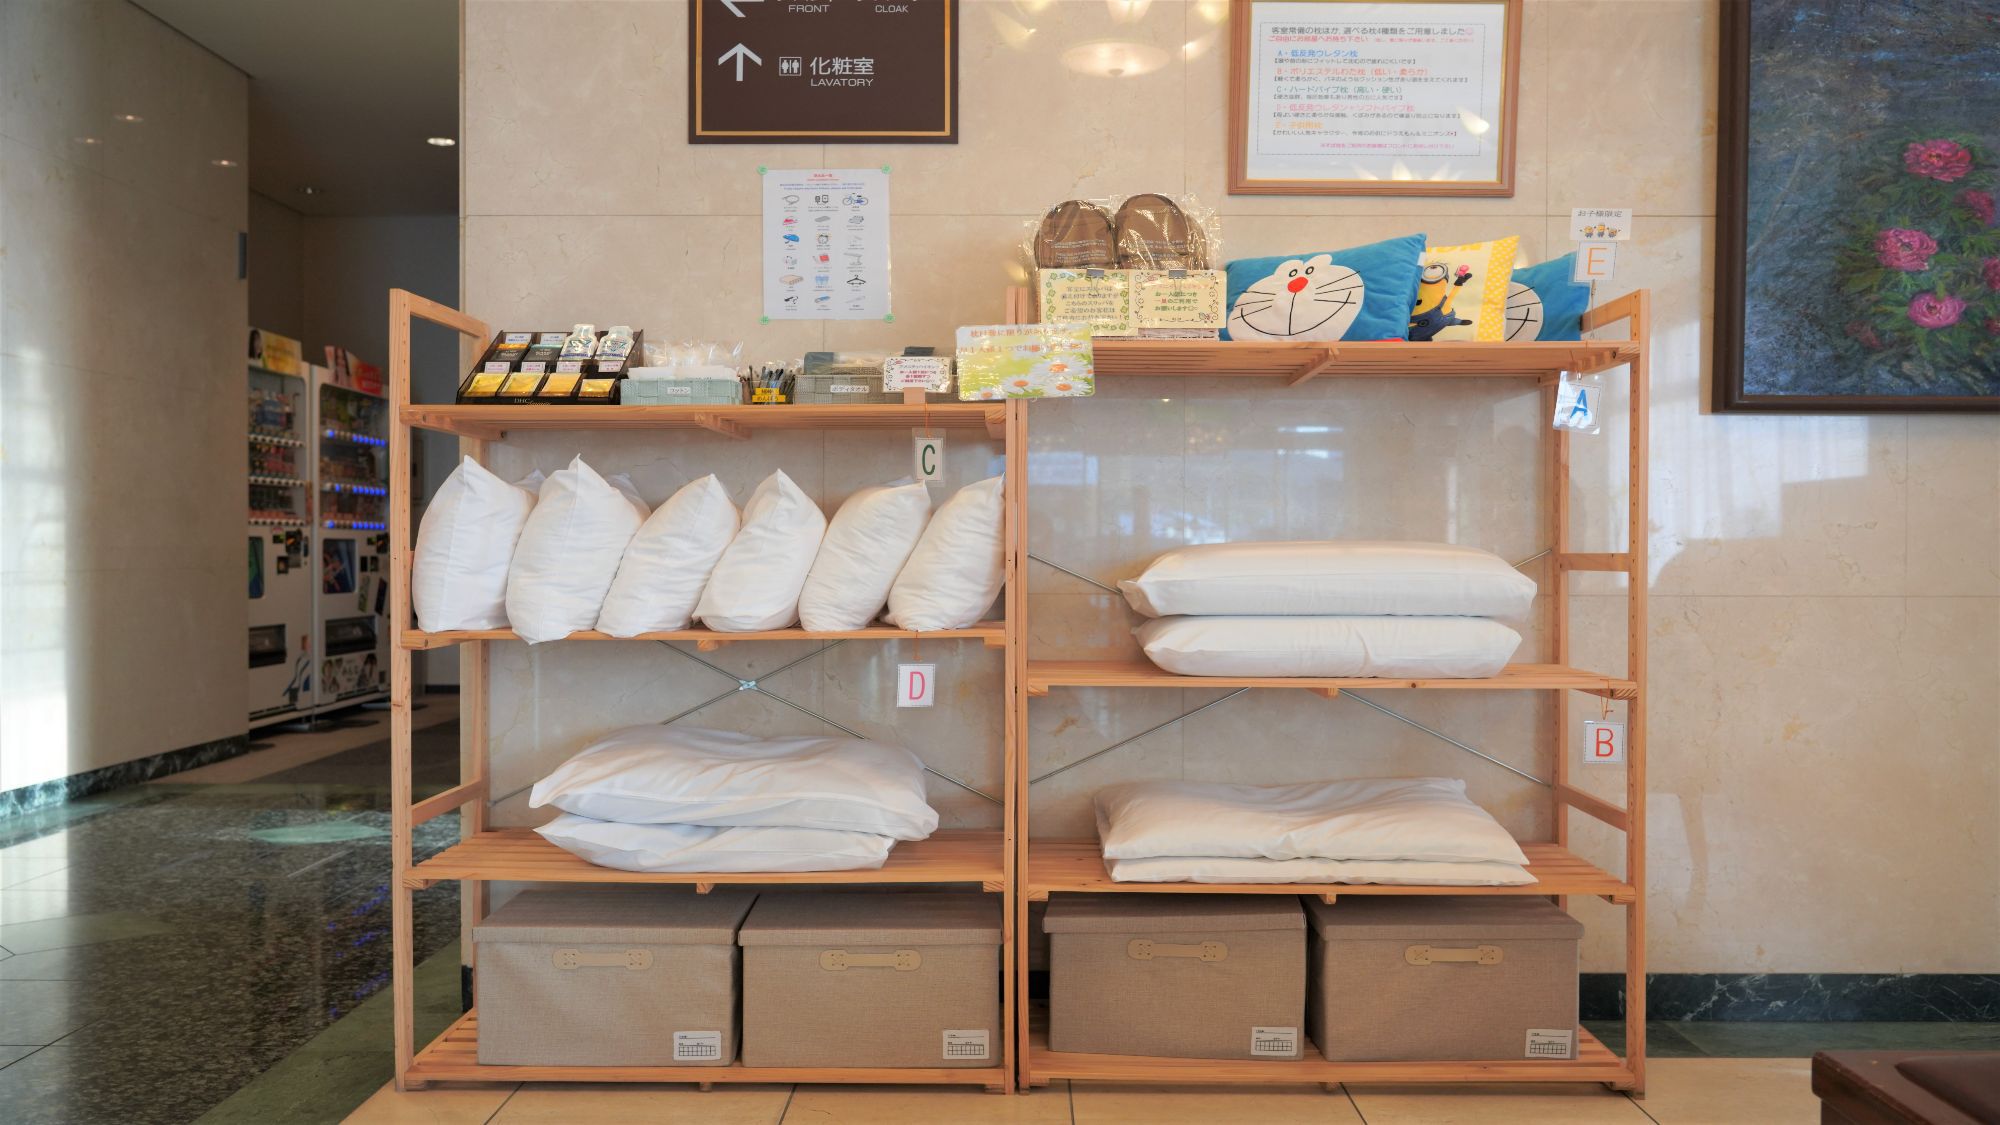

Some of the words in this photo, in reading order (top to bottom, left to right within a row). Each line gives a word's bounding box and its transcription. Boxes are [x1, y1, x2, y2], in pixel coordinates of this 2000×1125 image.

[788, 4, 830, 13] FRONT
[875, 4, 908, 13] CLOAK
[810, 56, 875, 75] 化粧室
[810, 78, 874, 87] LAVATORY
[1586, 247, 1607, 276] E
[1569, 388, 1589, 419] A
[922, 443, 936, 476] C
[908, 670, 926, 701] D
[1595, 728, 1614, 758] B
